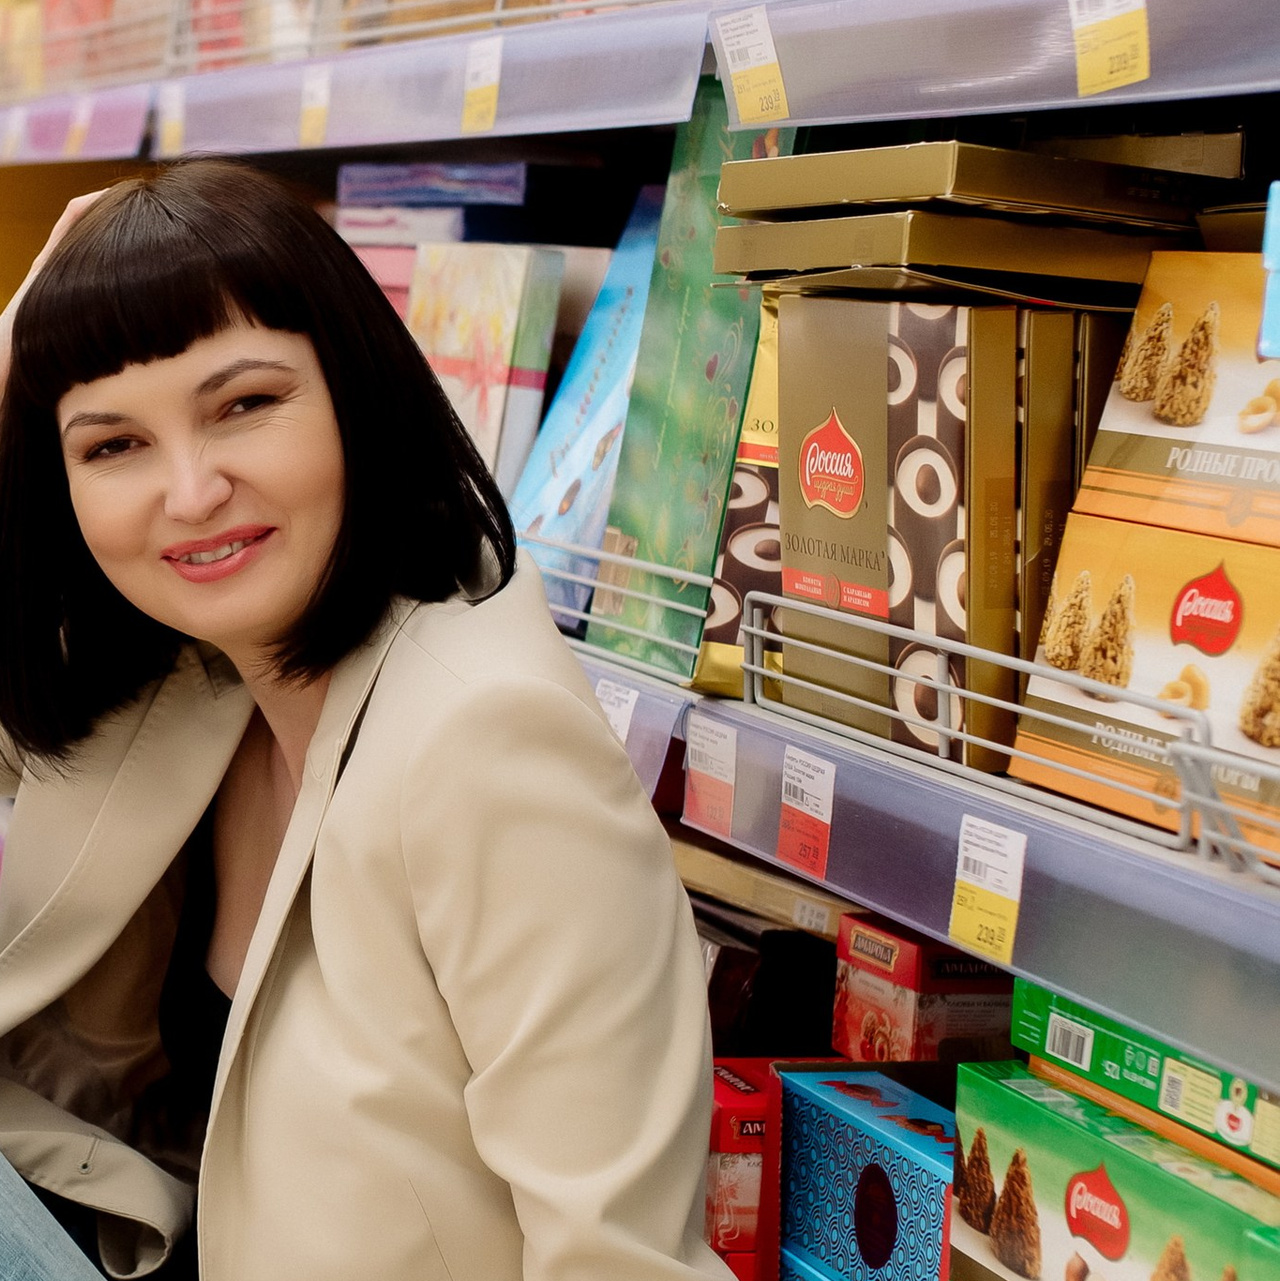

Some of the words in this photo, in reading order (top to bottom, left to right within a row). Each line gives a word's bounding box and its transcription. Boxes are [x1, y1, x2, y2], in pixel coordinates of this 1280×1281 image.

[759, 93, 774, 113] 239
[750, 417, 779, 435] ЗО
[805, 442, 854, 487] Россия
[1165, 446, 1241, 479] РОДНЫЕ
[784, 532, 838, 562] ЗОЛОТАЯ
[840, 544, 881, 572] МАРКА
